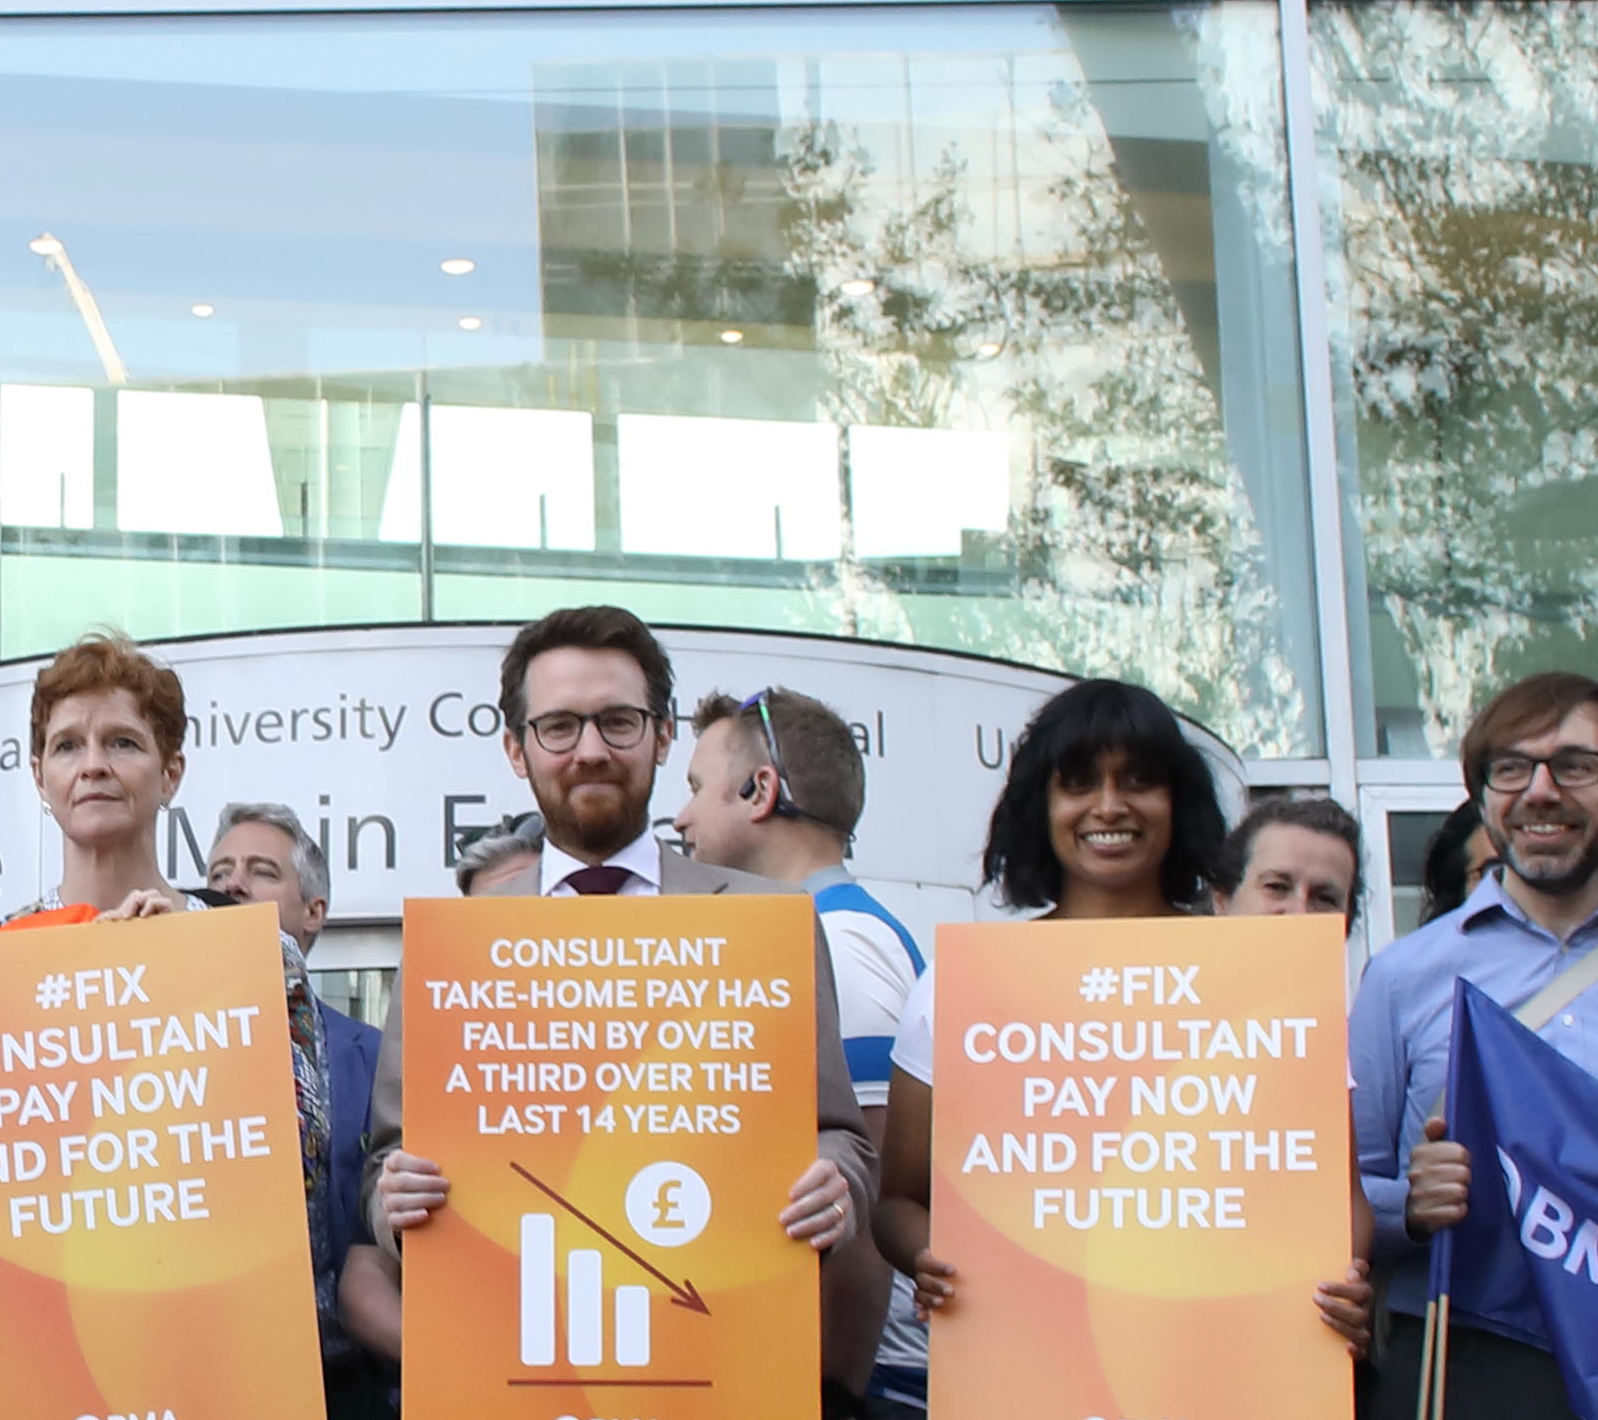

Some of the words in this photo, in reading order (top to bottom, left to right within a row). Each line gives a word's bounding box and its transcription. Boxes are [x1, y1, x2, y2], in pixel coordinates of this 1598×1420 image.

[186, 693, 406, 752] niversity
[166, 793, 397, 881] Min
[489, 937, 727, 968] CONSULTANT
[34, 963, 151, 1010] #FIX
[425, 979, 637, 1009] TAKE-HOME
[645, 979, 709, 1007] PAY
[717, 978, 791, 1008] HAS
[1077, 964, 1201, 1007] #FIX
[463, 1021, 596, 1051] FALLEN
[605, 1020, 649, 1050] BY
[656, 1019, 755, 1050] OVER
[961, 1017, 1318, 1064] CONSULTANT
[90, 1066, 209, 1117] NOW
[445, 1064, 471, 1092] A
[477, 1062, 587, 1093] THIRD
[594, 1062, 693, 1092] OVER
[700, 1062, 771, 1092] THE
[1022, 1075, 1117, 1117] PAY
[1129, 1073, 1257, 1117] NOW
[477, 1104, 567, 1135] LAST
[576, 1105, 616, 1133] 14
[623, 1104, 741, 1134] YEARS
[58, 1128, 159, 1176] FOR
[166, 1115, 271, 1165] THE
[960, 1131, 1078, 1175] AND
[1090, 1130, 1198, 1173] FOR
[1206, 1129, 1318, 1173] THE
[9, 1177, 210, 1237] FUTURE
[1032, 1186, 1247, 1230] FUTURE
